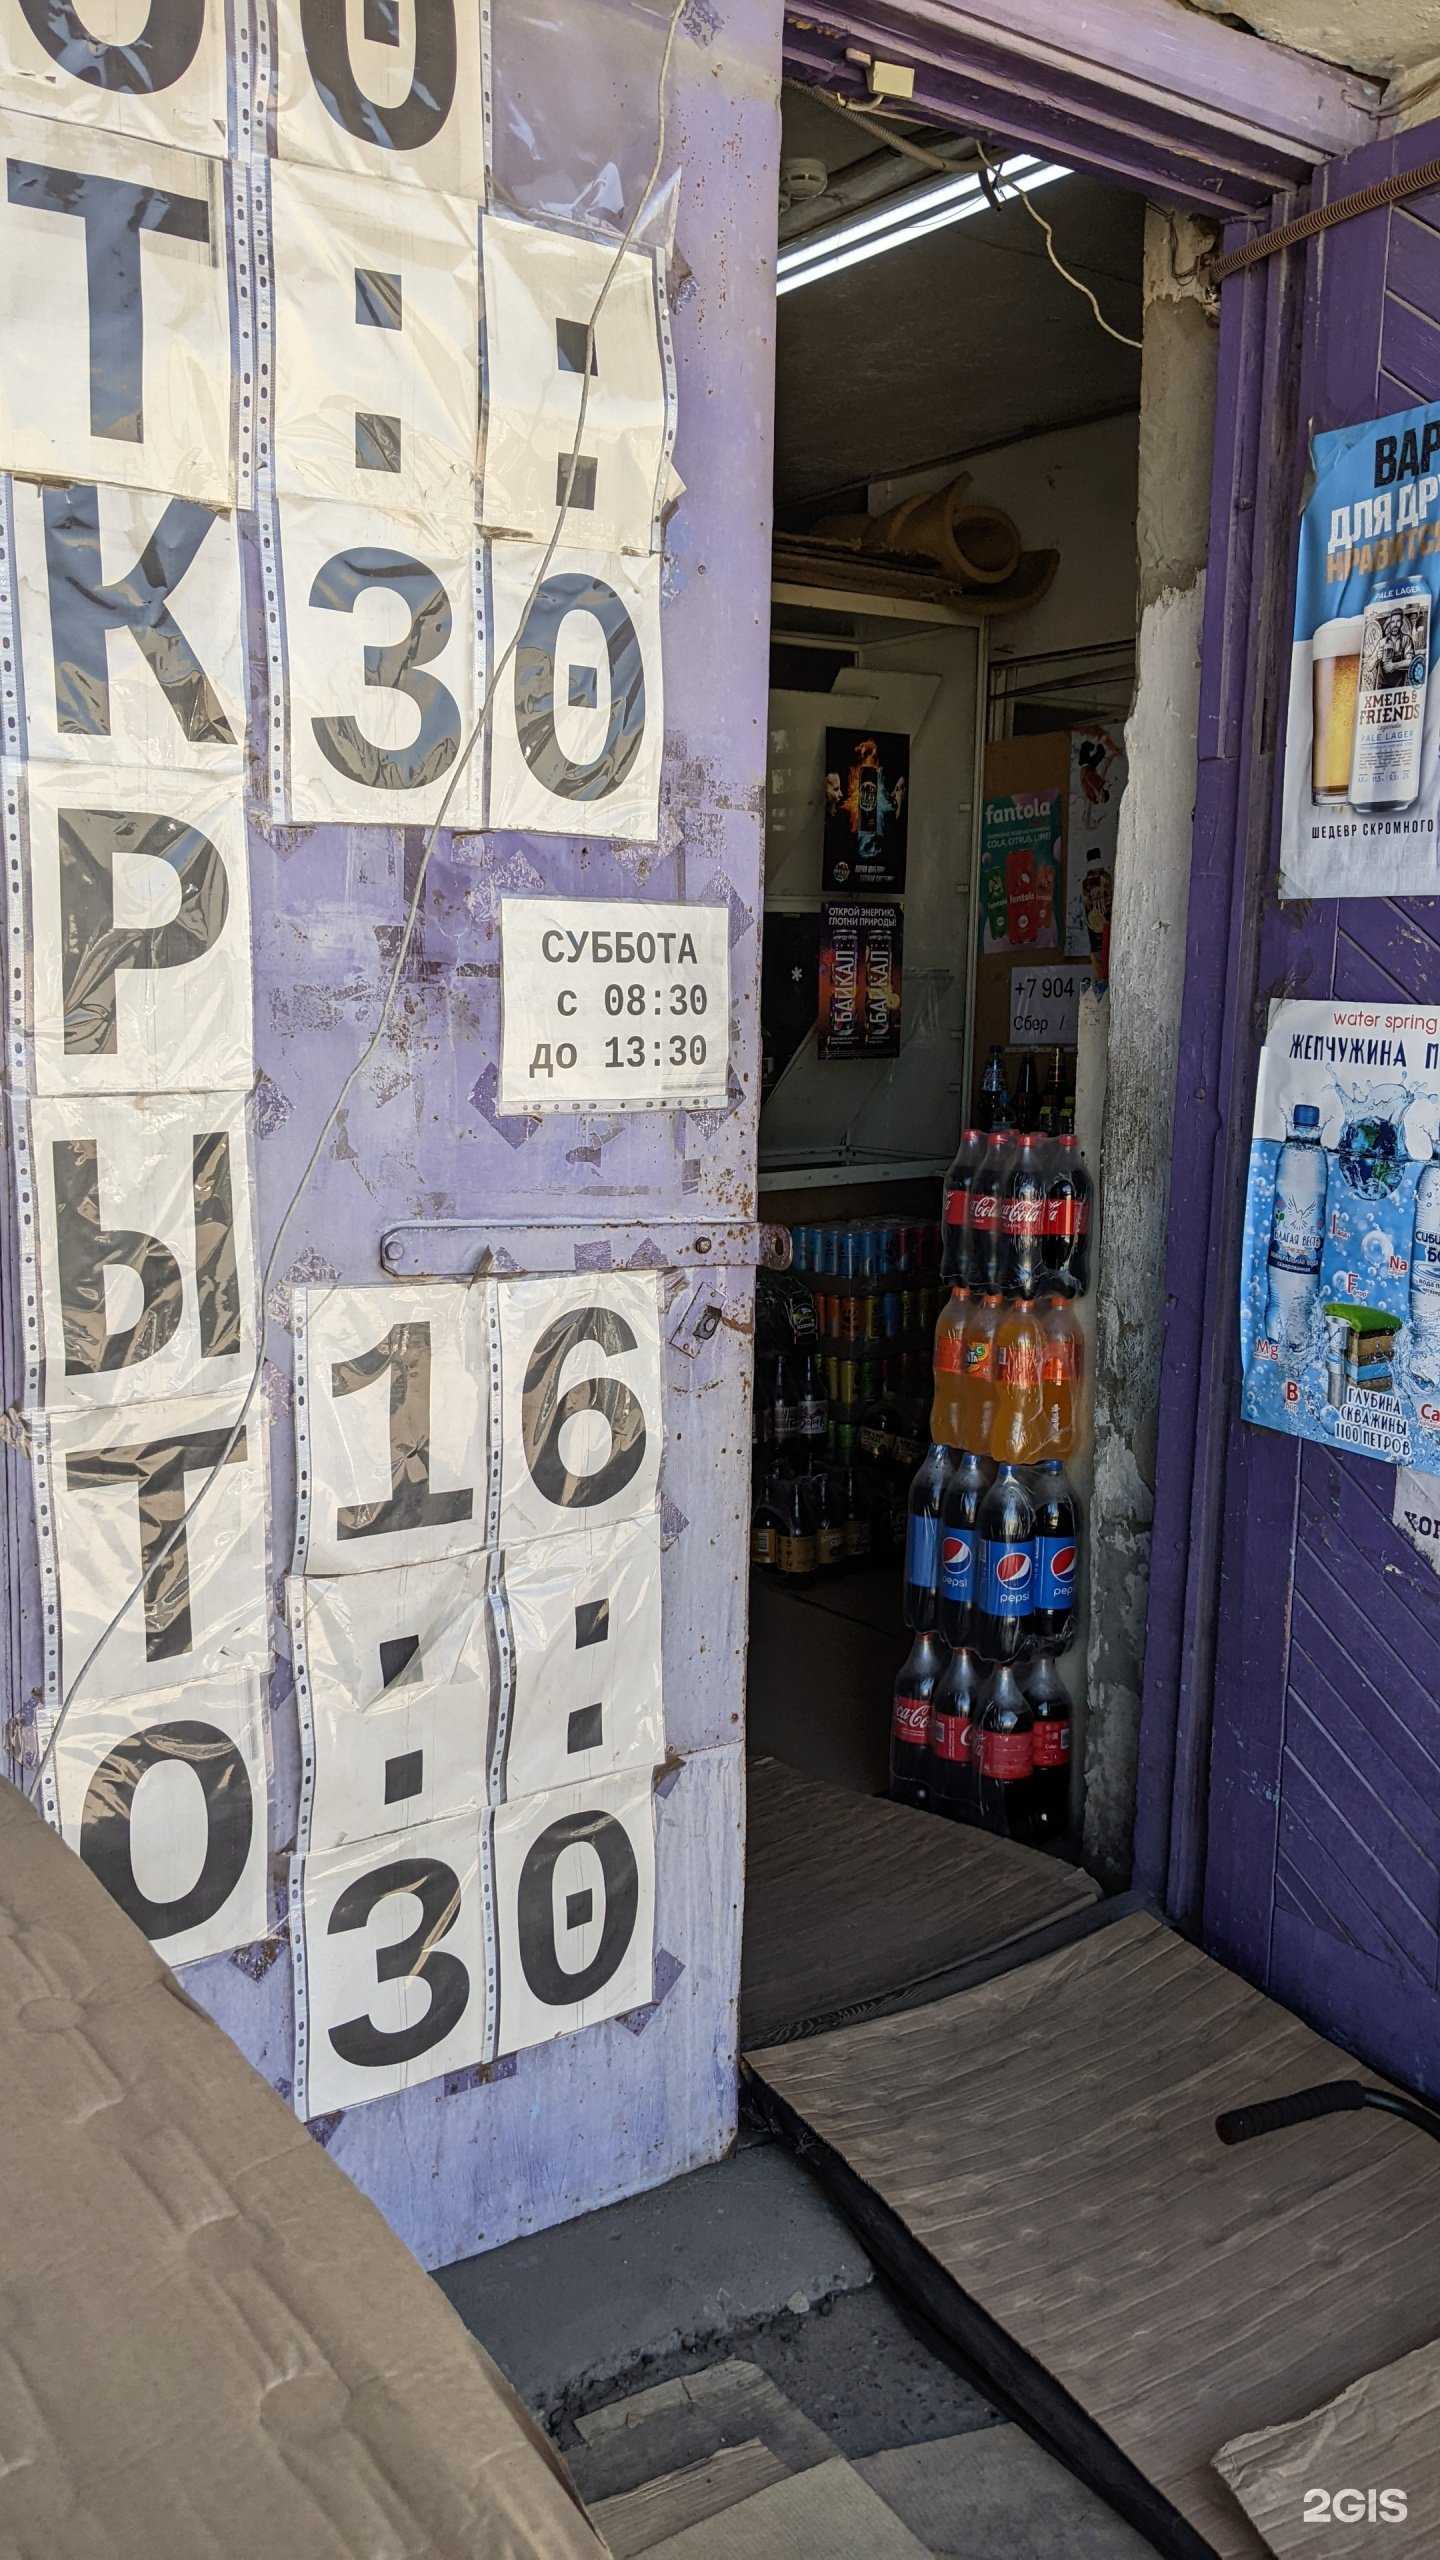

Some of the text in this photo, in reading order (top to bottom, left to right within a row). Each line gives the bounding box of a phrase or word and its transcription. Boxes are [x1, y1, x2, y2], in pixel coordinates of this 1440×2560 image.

[1327, 474, 1440, 554] ДЛЯ ДР
[307, 545, 647, 802] 30
[1365, 691, 1410, 708] ХМЕЛЬ
[1359, 704, 1420, 725] FRIENDS
[985, 798, 1051, 824] fantola
[1312, 818, 1434, 840] ШЕДЕВР СКРОМНОГО
[828, 906, 860, 917] ОТКРОЙ
[828, 917, 858, 926] ГЛОТНИ
[541, 929, 698, 964] СУББОТА
[604, 983, 708, 1016] 08:30
[1015, 978, 1037, 999] +7
[1041, 977, 1075, 998] 904
[1013, 1015, 1049, 1034] Сбер
[1333, 1010, 1439, 1035] water spring
[604, 1034, 708, 1068] 13:30
[1289, 1033, 1407, 1067] ЖЕМЧУЖИНА
[1389, 1255, 1409, 1271] Na
[1256, 1339, 1280, 1360] Mg
[1348, 1387, 1401, 1415] ГЛУБИНА
[1420, 1403, 1440, 1422] Ca
[330, 1306, 647, 1542] 16
[1341, 1405, 1407, 1436] СКВАЖИНЫ
[1336, 1423, 1359, 1442] 1100
[1000, 1592, 1030, 1604] pepsi
[327, 1809, 640, 2068] 30
